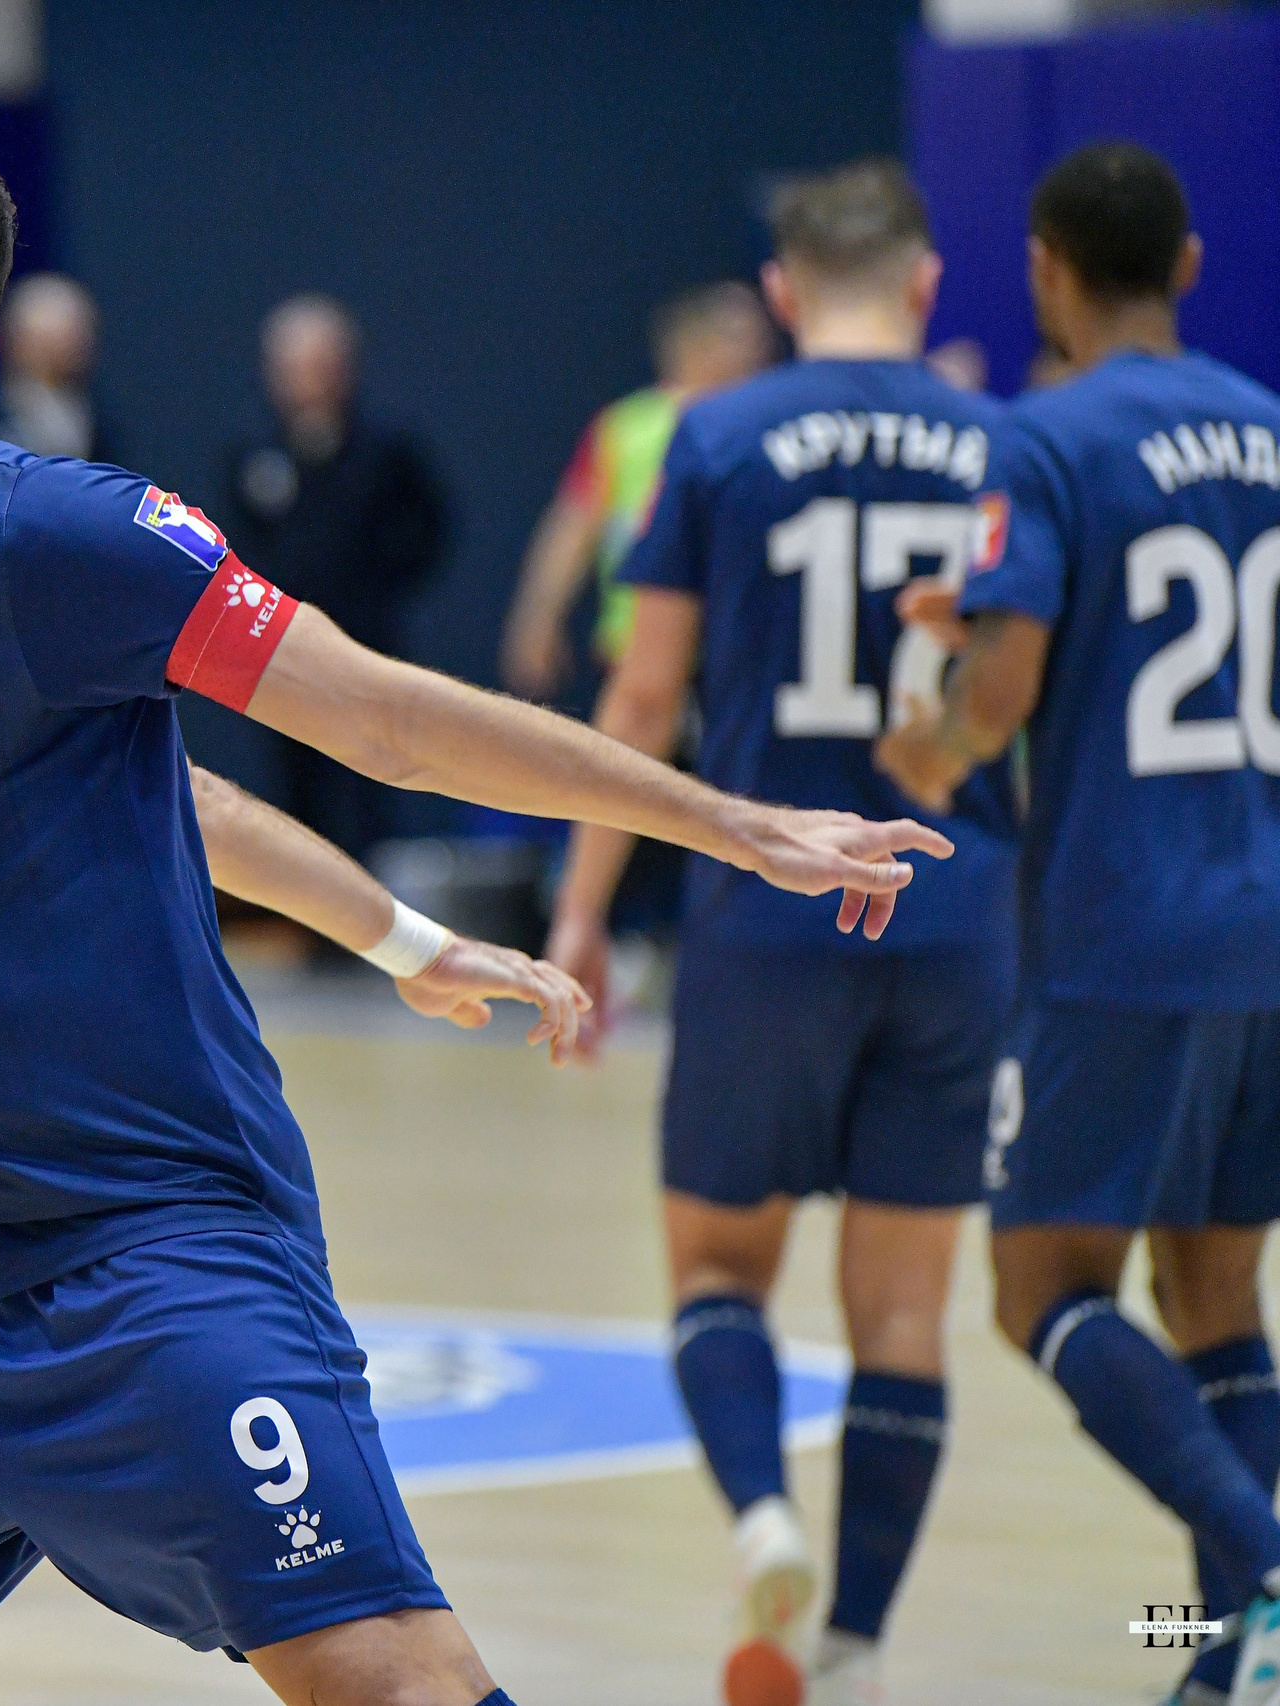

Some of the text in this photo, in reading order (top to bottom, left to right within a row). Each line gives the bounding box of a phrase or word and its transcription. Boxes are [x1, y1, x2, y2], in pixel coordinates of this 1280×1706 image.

[1138, 420, 1280, 495] НАНД
[249, 585, 284, 638] KELM
[766, 496, 982, 738] 17
[230, 1396, 310, 1505] 9
[275, 1539, 345, 1571] KELME
